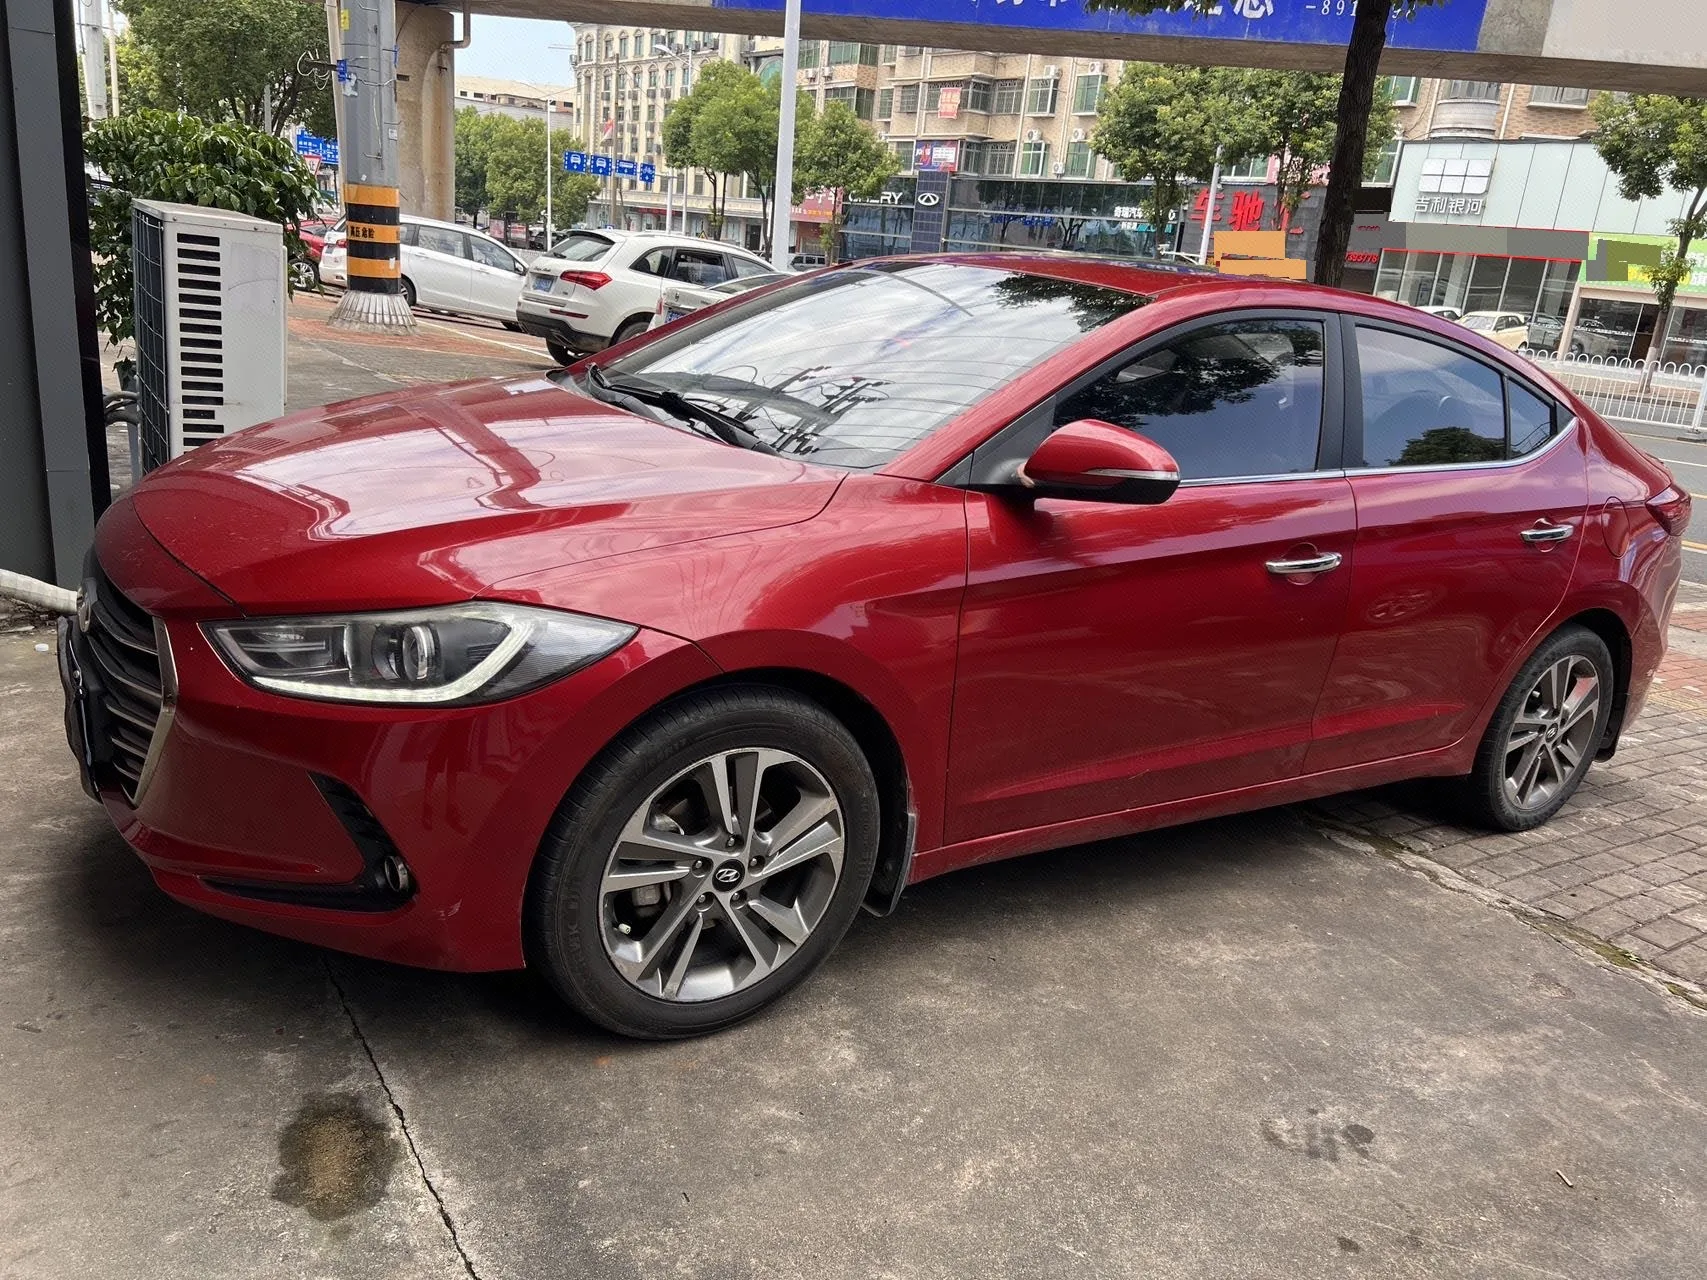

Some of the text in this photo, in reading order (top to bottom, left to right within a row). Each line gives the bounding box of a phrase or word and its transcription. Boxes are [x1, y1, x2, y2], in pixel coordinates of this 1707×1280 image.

[1414, 195, 1484, 215] 吉利银河
[350, 226, 375, 239] 高压危险
